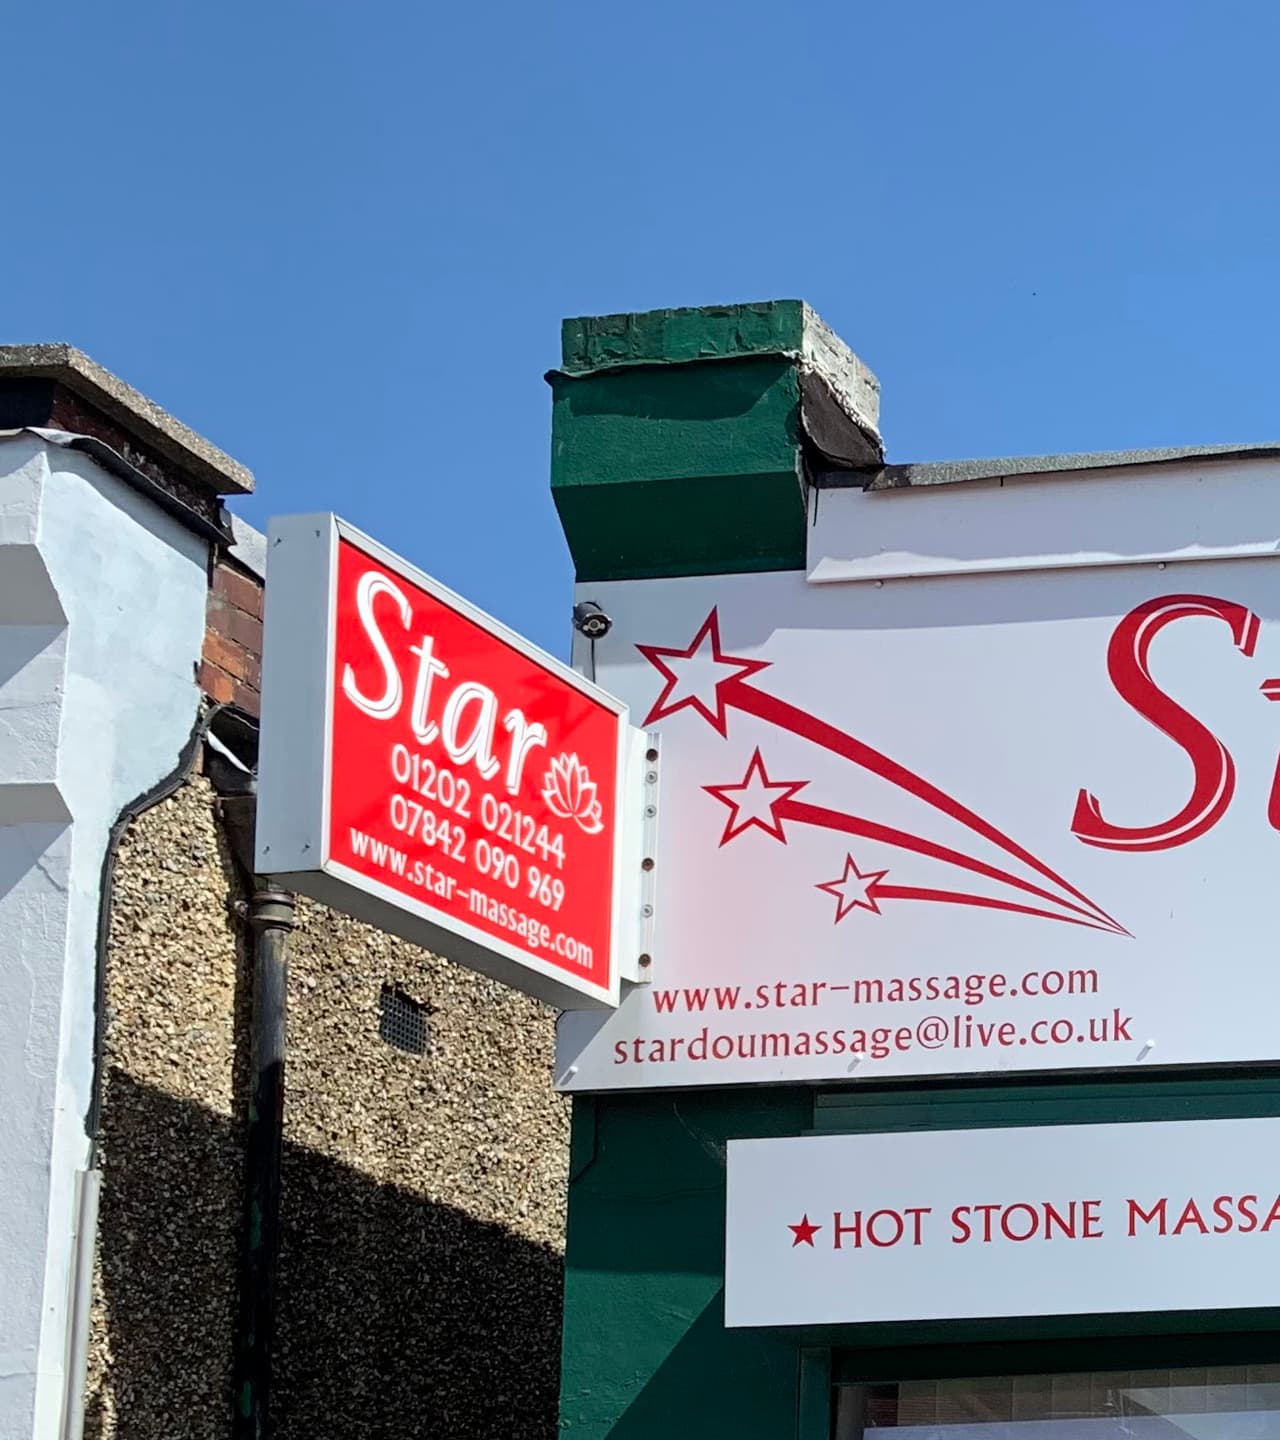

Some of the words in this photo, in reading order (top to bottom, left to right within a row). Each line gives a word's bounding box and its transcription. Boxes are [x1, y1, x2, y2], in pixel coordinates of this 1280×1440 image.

[343, 571, 547, 796] Star
[390, 794, 467, 863] 07842
[475, 839, 520, 889] 090
[528, 866, 566, 911] 969
[391, 744, 472, 819] 01202
[481, 793, 566, 869] 021244
[350, 827, 594, 969] www.star-massage.com
[613, 1007, 1133, 1065] stardoumassage@live.co.uk
[653, 968, 1100, 1014] www.star-massage.com
[833, 1207, 930, 1249] HOT
[950, 1199, 1102, 1244] STONE
